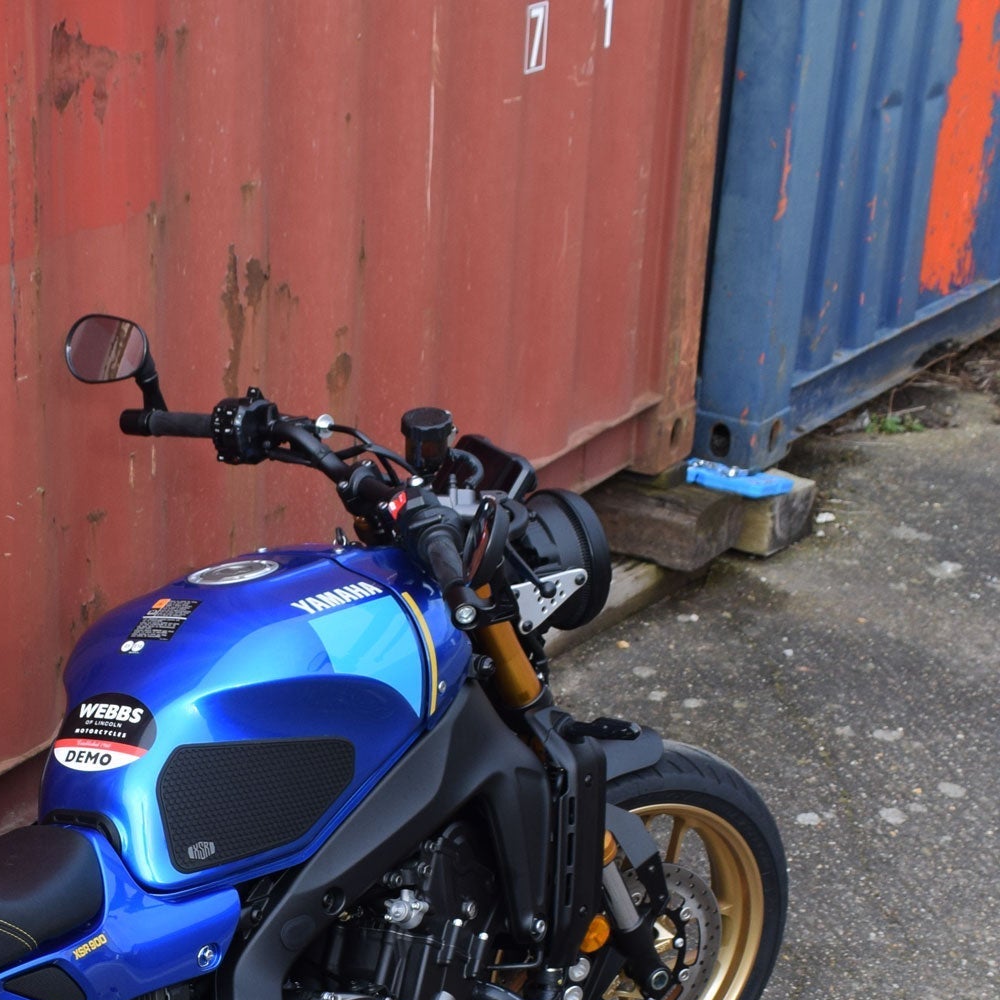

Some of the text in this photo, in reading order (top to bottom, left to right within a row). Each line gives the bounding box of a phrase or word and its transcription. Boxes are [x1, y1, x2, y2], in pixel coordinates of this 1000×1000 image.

[528, 6, 546, 69] 7
[290, 581, 383, 614] YAMAHA
[79, 702, 144, 724] WEBBS
[74, 728, 127, 738] MOTORCYCLES
[94, 720, 123, 728] LINCOLN
[65, 750, 112, 766] DEMO
